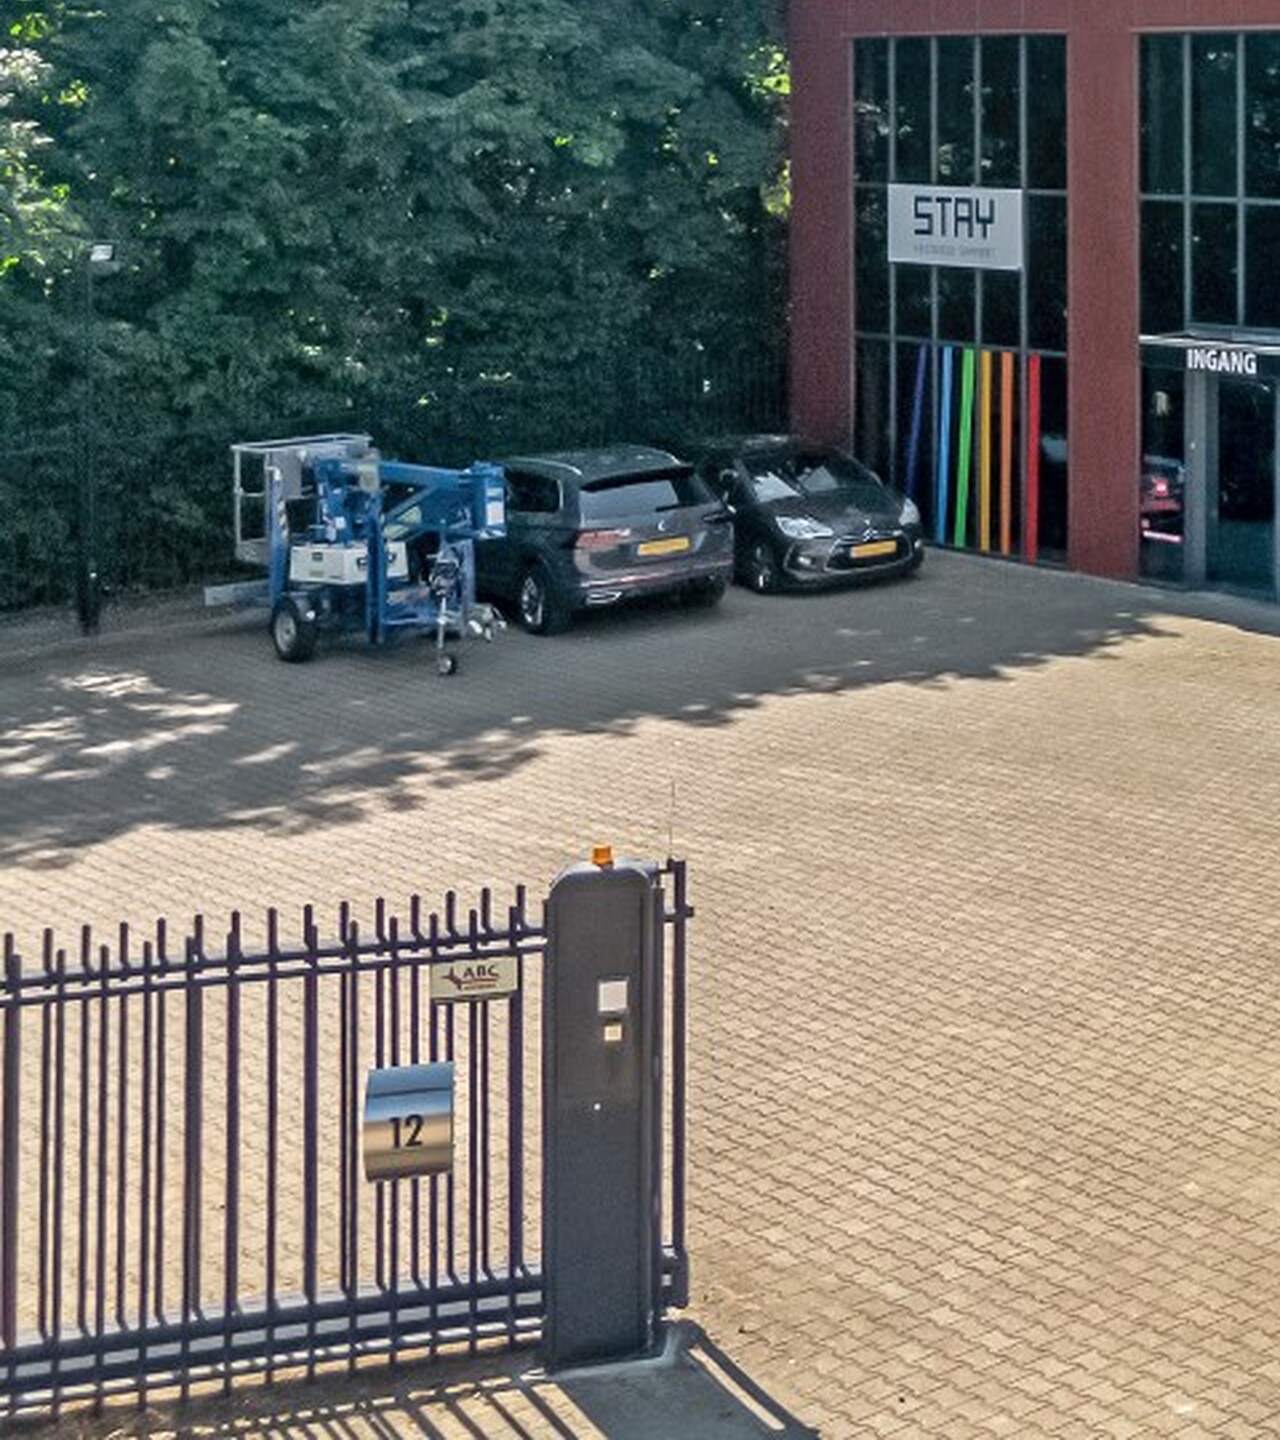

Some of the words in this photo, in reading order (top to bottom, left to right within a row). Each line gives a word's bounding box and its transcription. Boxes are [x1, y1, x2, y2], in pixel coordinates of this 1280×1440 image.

[914, 195, 995, 240] STAY
[1187, 348, 1257, 375] INGANG
[463, 965, 499, 978] ABC
[389, 1114, 424, 1149] 12
